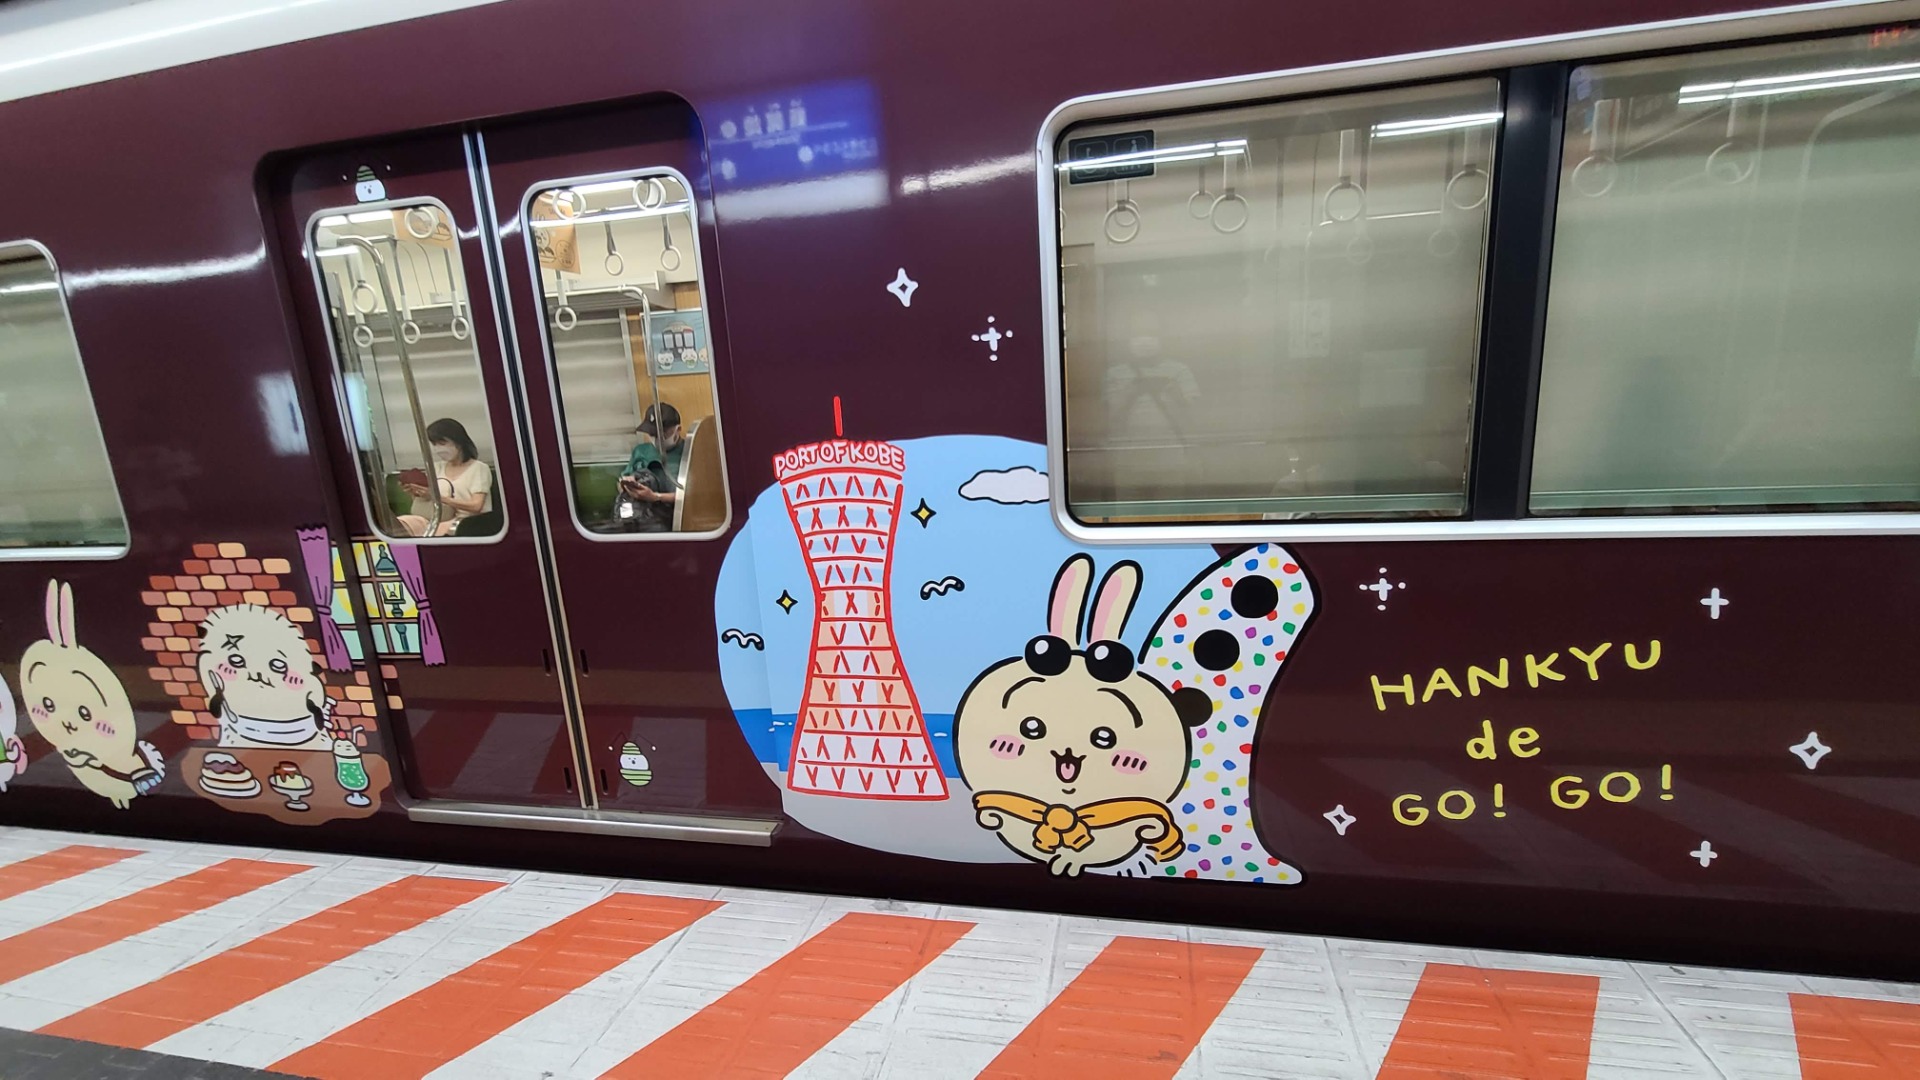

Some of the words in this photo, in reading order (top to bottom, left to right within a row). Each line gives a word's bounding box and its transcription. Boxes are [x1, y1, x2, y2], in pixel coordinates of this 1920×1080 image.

[773, 445, 819, 479] PORT
[819, 440, 849, 464] OF
[850, 441, 904, 472] KOBE
[1370, 639, 1662, 711] HANKYU
[1465, 719, 1541, 760] de
[1391, 783, 1507, 826] GO!
[1549, 763, 1674, 809] GO!
